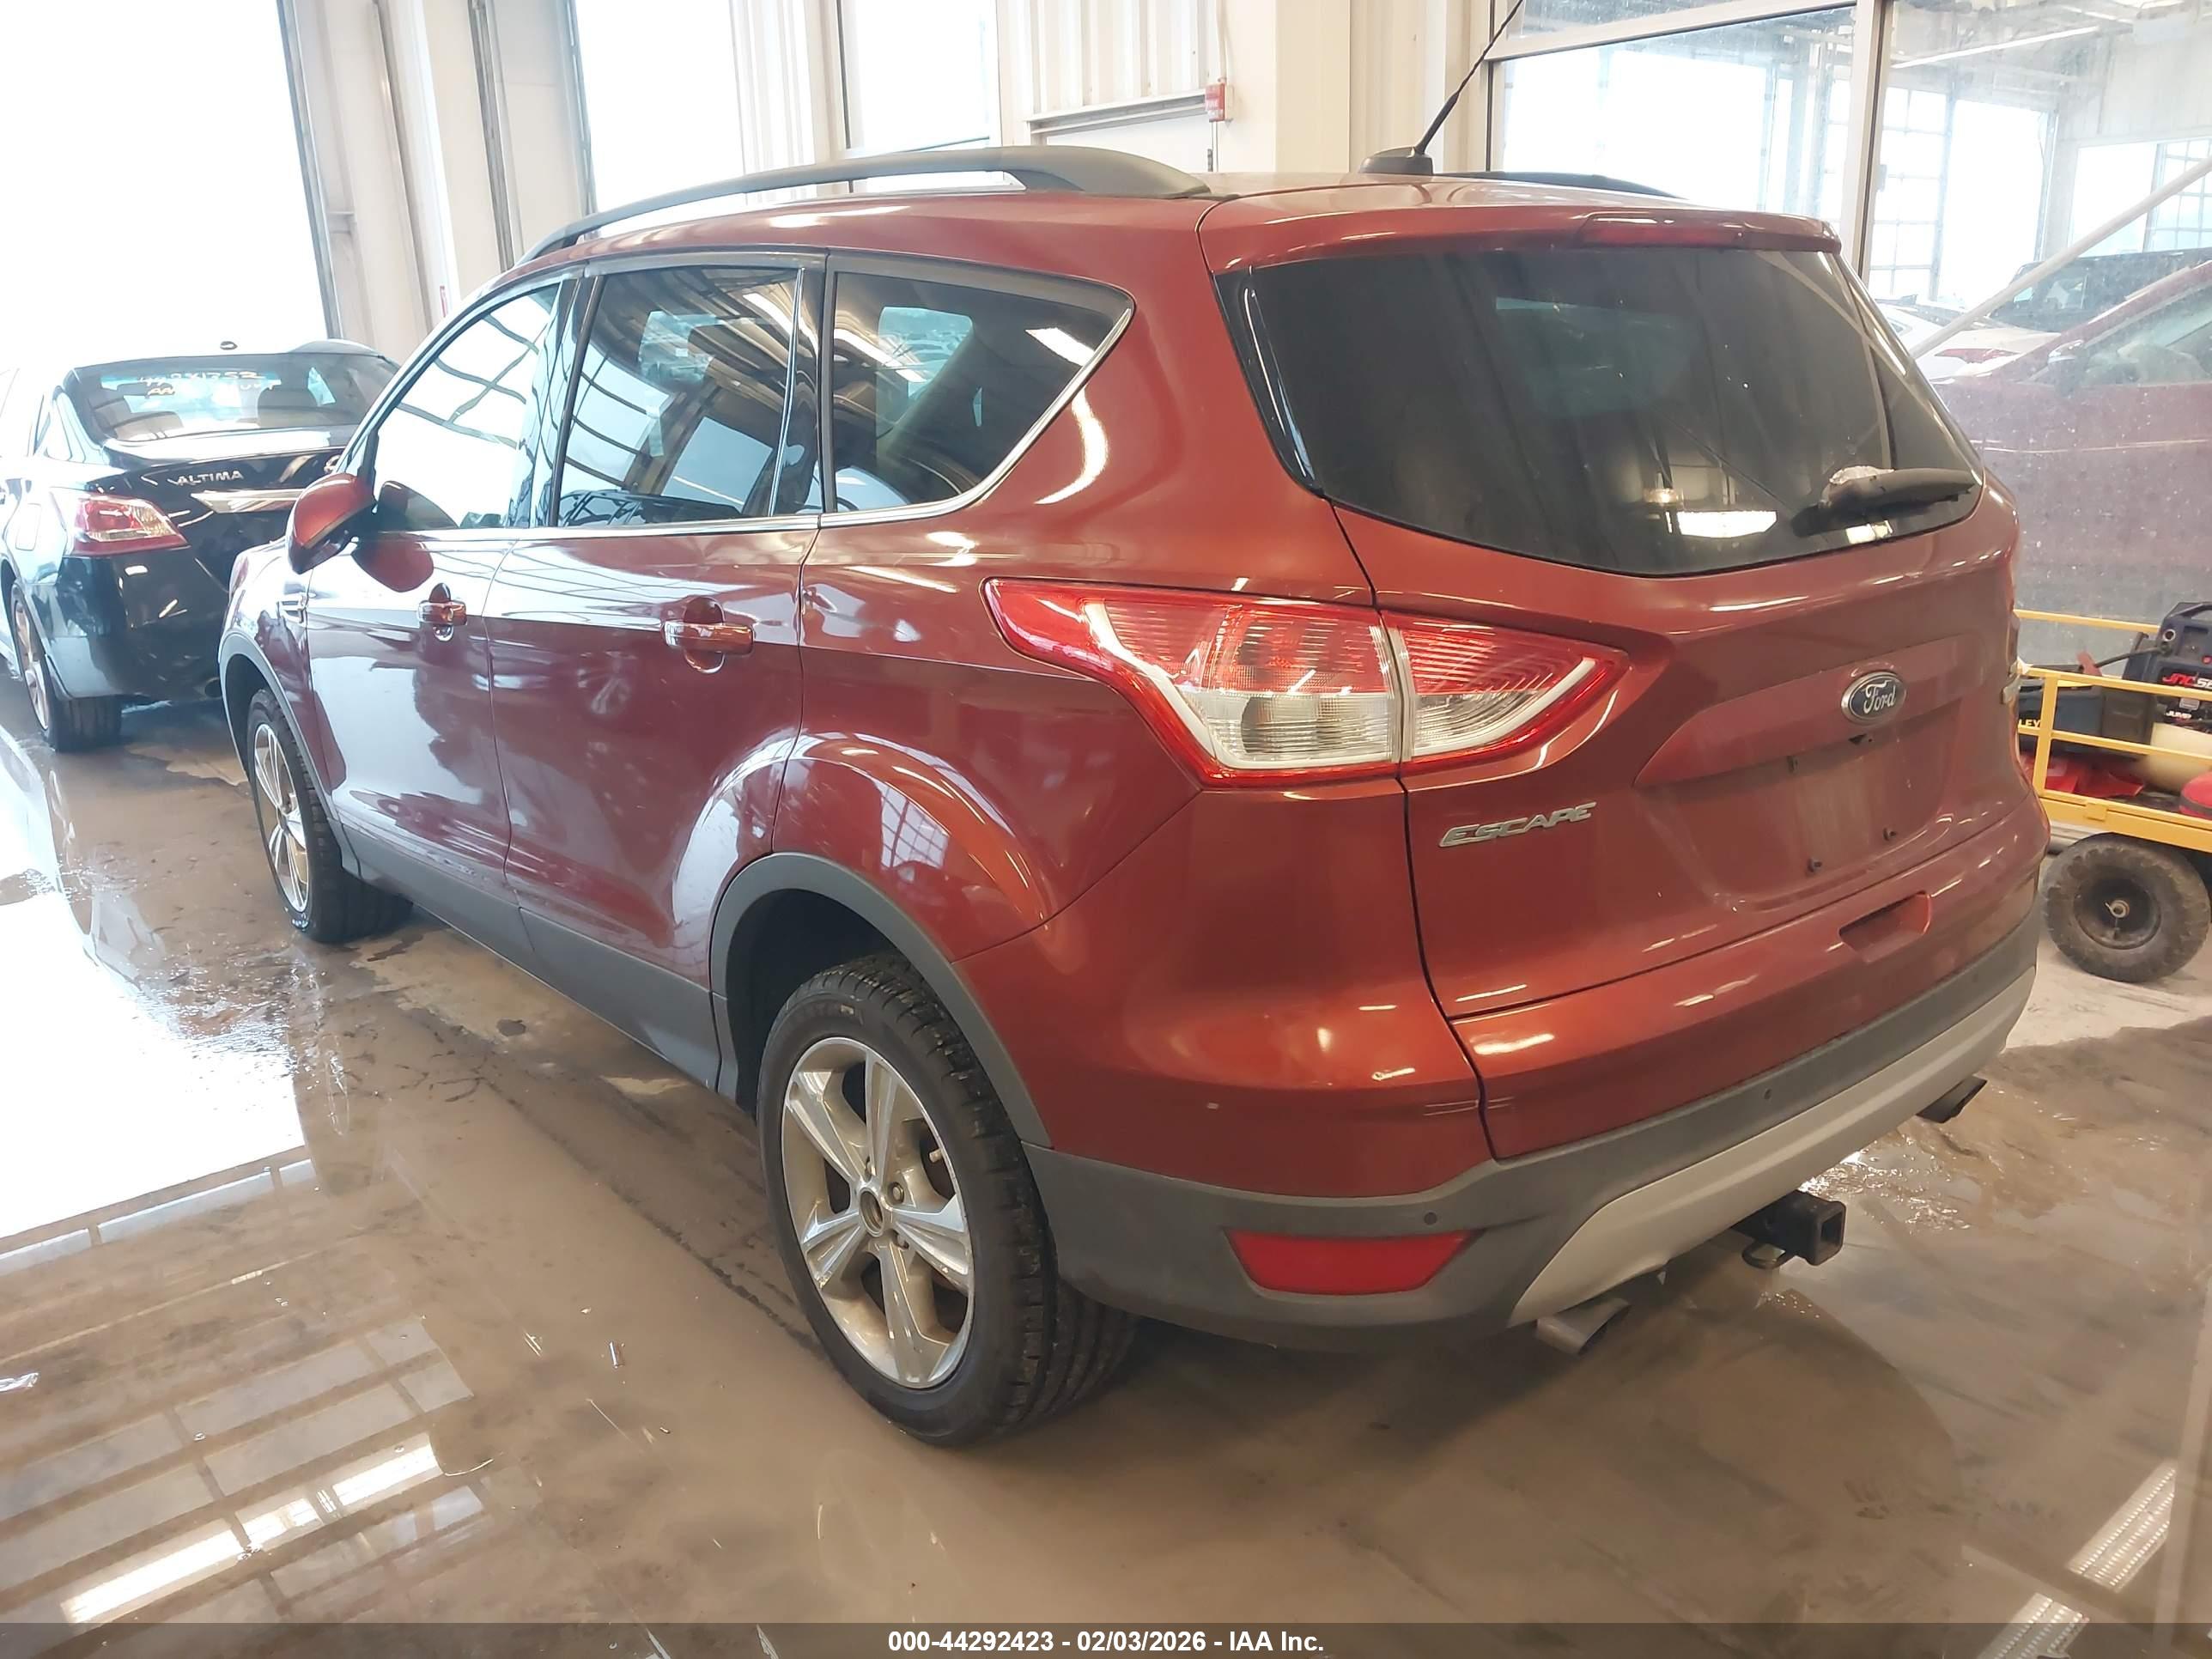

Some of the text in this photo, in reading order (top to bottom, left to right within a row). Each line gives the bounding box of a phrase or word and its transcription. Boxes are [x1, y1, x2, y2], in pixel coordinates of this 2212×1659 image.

[177, 470, 244, 486] ALTIMA
[1863, 679, 1896, 714] Ford
[1439, 801, 1597, 848] ESCAPE
